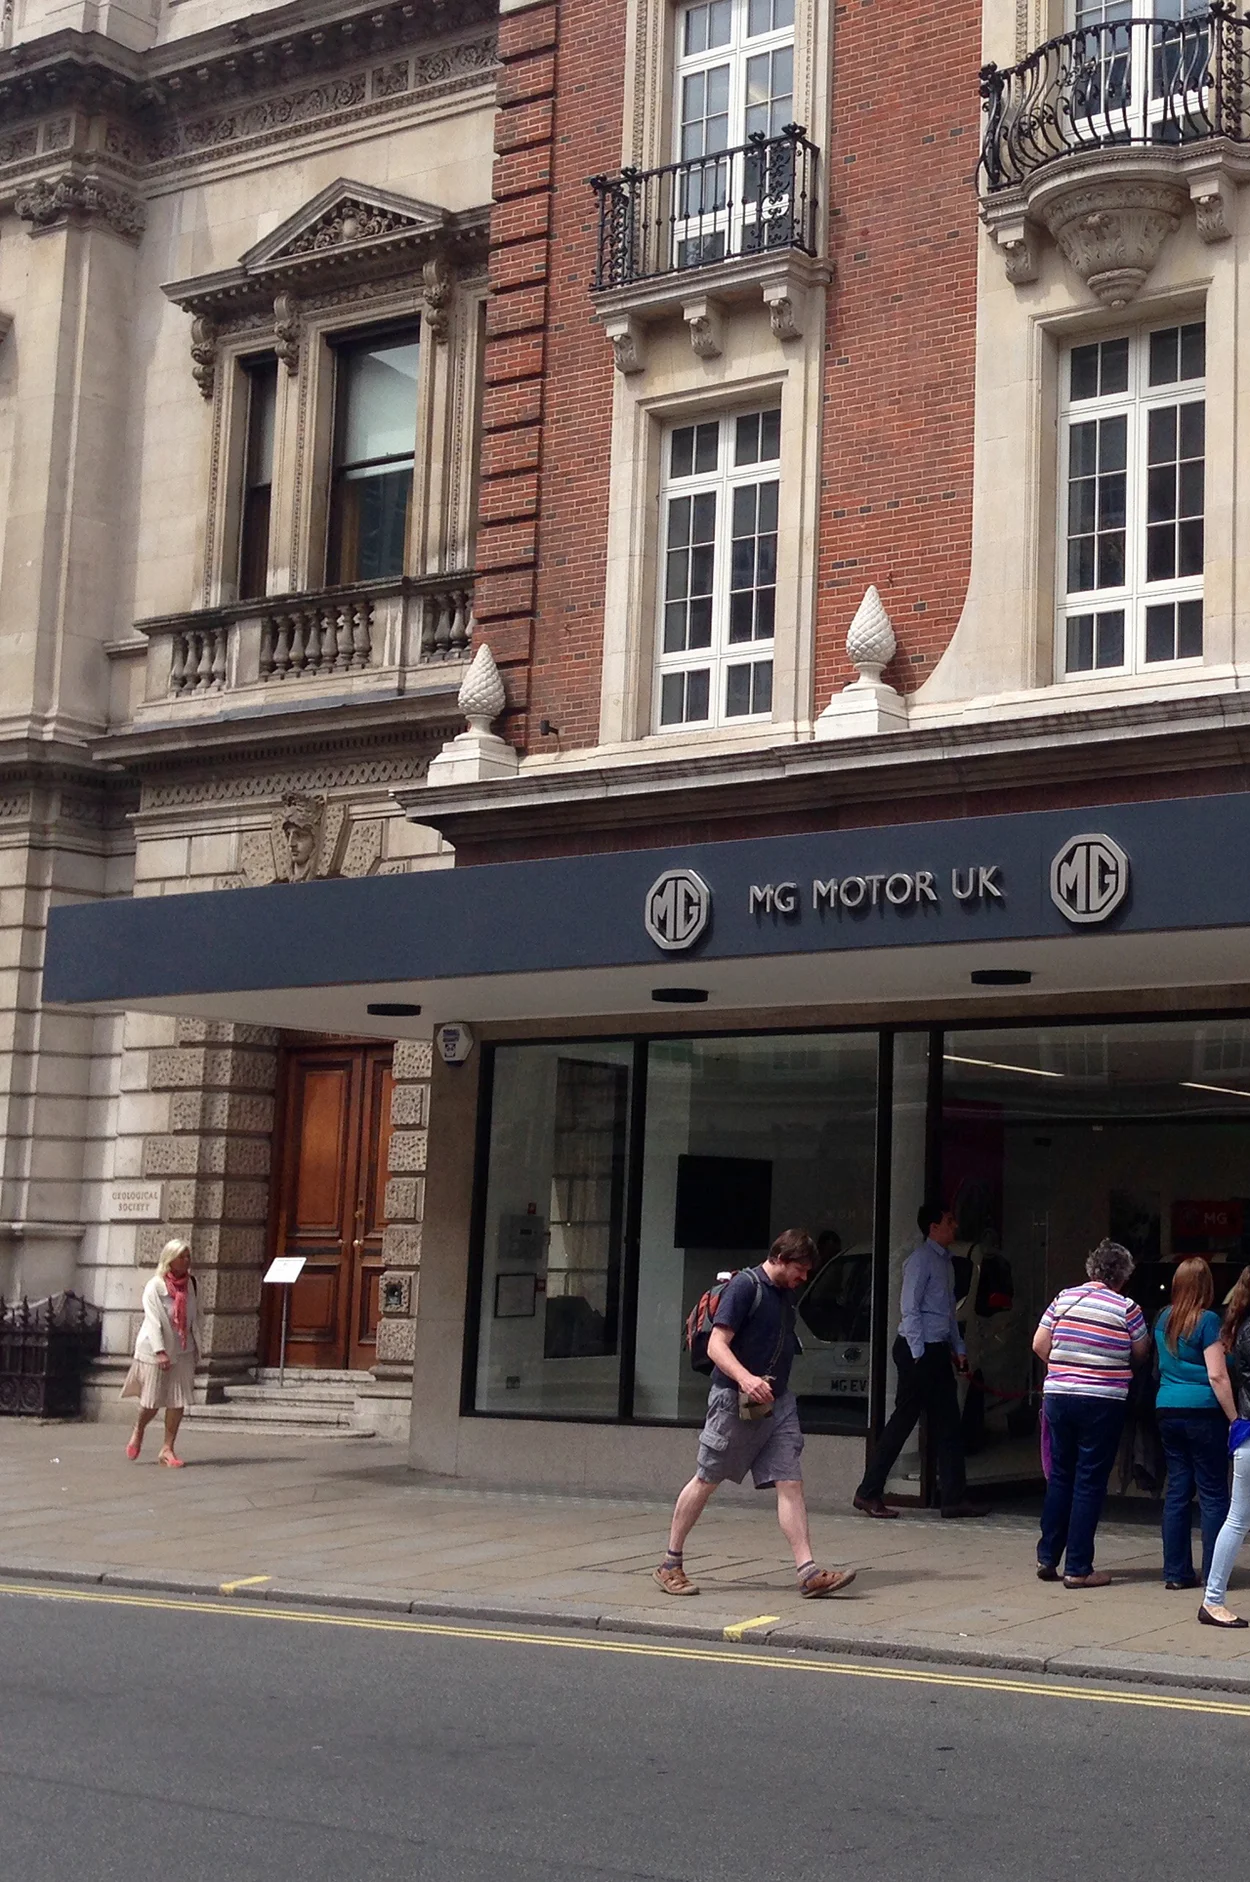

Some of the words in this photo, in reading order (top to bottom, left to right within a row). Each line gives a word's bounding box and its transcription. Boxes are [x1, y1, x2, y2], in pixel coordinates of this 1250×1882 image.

[750, 882, 797, 914] MG
[813, 871, 938, 909] MOTOR
[952, 866, 1002, 899] UK
[1058, 844, 1118, 913] MG
[652, 879, 701, 941] MG
[111, 1191, 158, 1200] GEOLOGICAL
[118, 1203, 151, 1211] SOCIETY
[1203, 1211, 1228, 1225] MG
